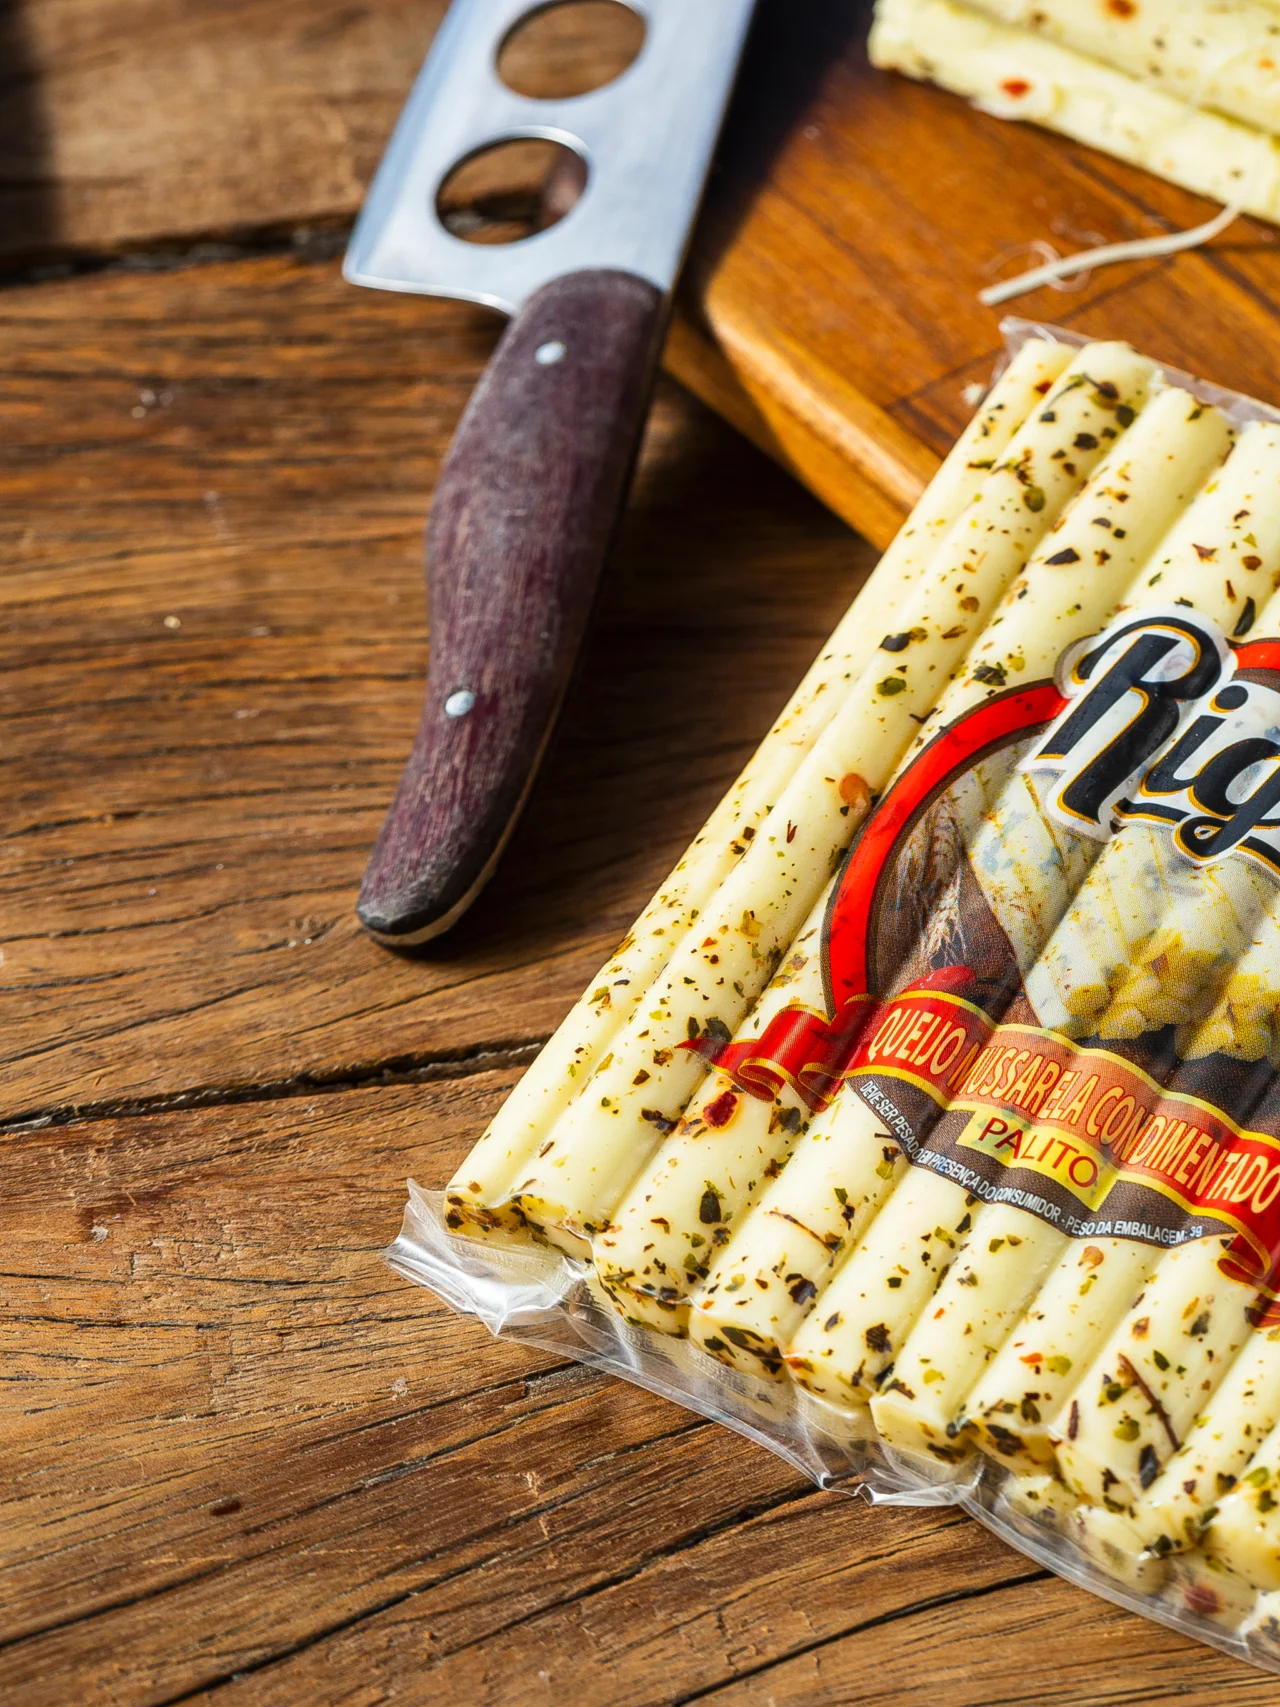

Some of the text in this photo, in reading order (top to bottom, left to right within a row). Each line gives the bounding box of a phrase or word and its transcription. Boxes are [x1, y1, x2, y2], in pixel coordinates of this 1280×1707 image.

[867, 1007, 967, 1075] QUEIJO
[946, 1042, 1100, 1126] MUSSARELA
[860, 1080, 881, 1105] DEVE
[875, 1098, 899, 1121] SER
[891, 1115, 923, 1160] PESADO
[918, 1148, 935, 1165] EM
[929, 1153, 981, 1189] PRESENÇA
[977, 1180, 997, 1200] DO
[993, 1187, 1062, 1221] CONSUMIDOR
[1064, 1215, 1095, 1236] PESO
[1096, 1220, 1112, 1235] DA
[978, 1117, 1098, 1188] PALITO
